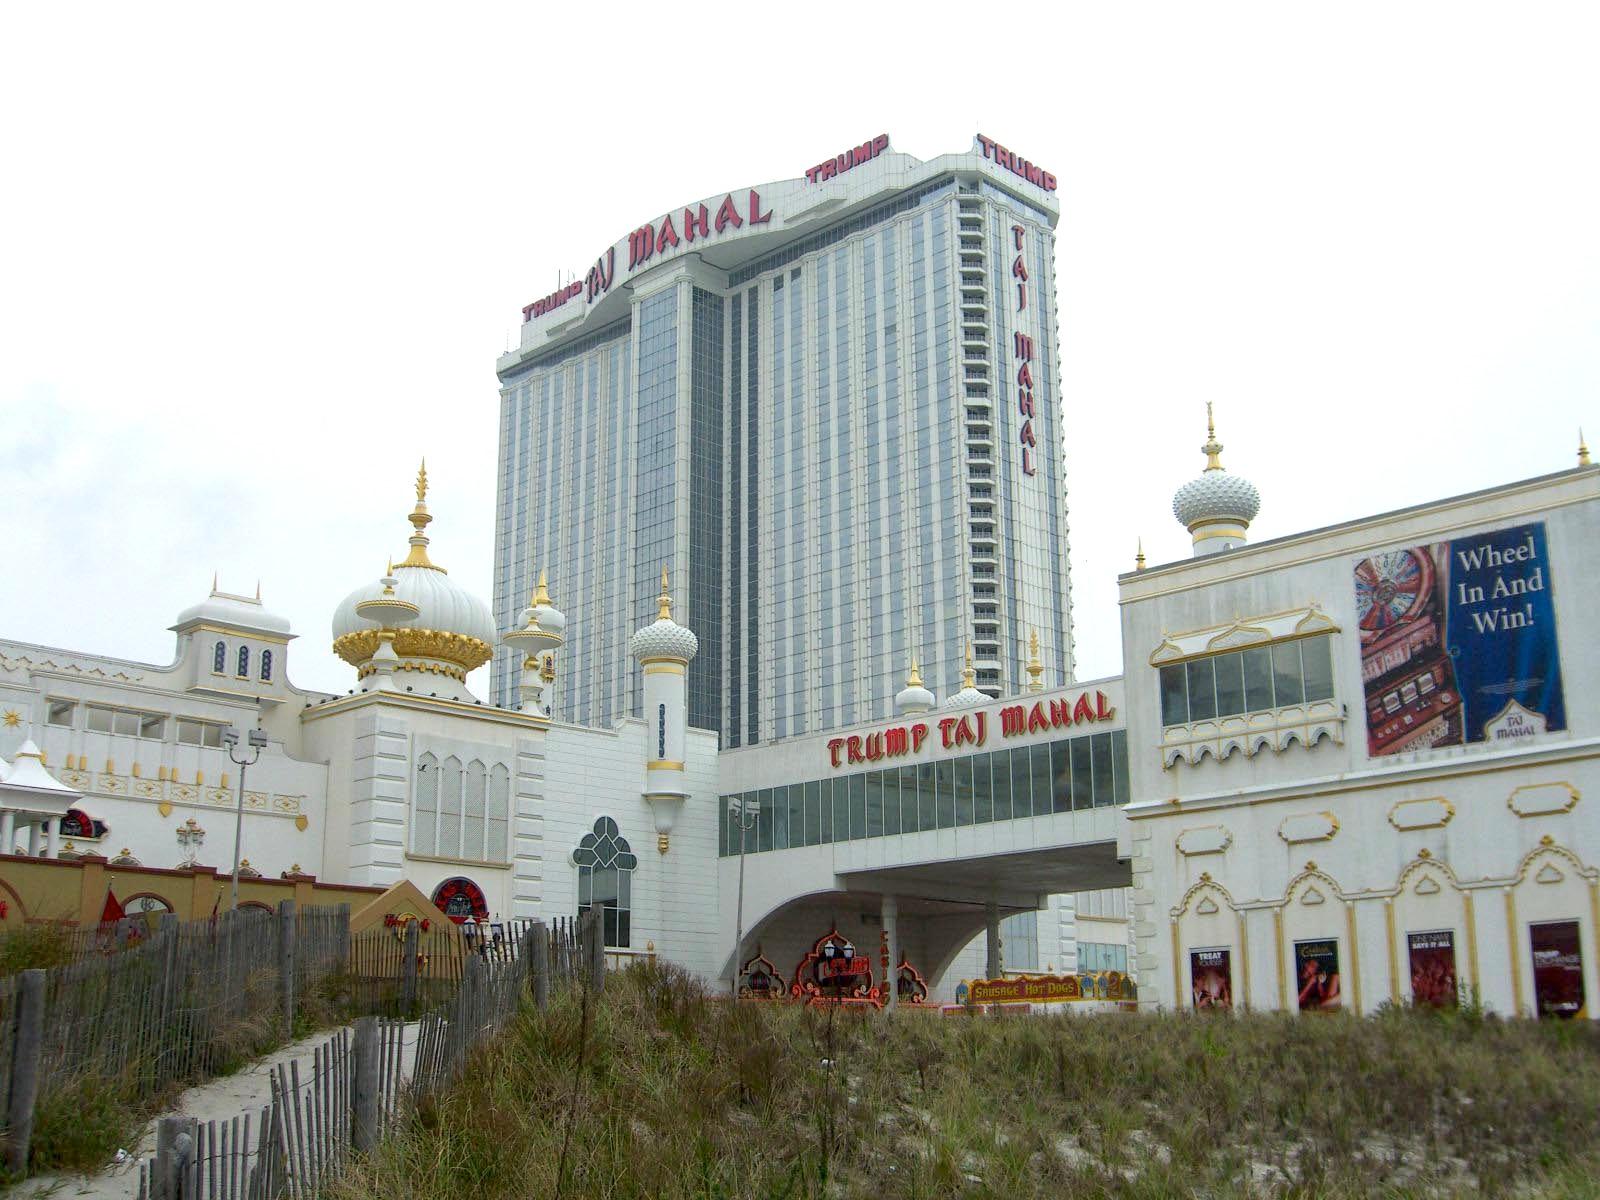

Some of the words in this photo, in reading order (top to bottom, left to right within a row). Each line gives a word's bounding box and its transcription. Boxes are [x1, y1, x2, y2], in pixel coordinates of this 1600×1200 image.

[805, 133, 889, 184] TRUMP
[977, 133, 1057, 191] TRUMP
[585, 246, 614, 304] TAJ
[628, 189, 773, 271] MAHAL
[1011, 224, 1028, 312] TAJ
[522, 280, 583, 322] TRUMP
[1014, 331, 1036, 477] MAHAL
[1458, 536, 1537, 573] Wheel
[1458, 583, 1485, 606] In
[1491, 567, 1545, 599] And
[1472, 603, 1535, 635] Win!
[827, 723, 929, 768] TRUMP
[938, 711, 988, 749] TAJ
[999, 691, 1116, 738] MAHAL
[975, 985, 1019, 998] SAUSAGE
[1025, 984, 1044, 995] HOT
[1049, 982, 1074, 995] DOGS
